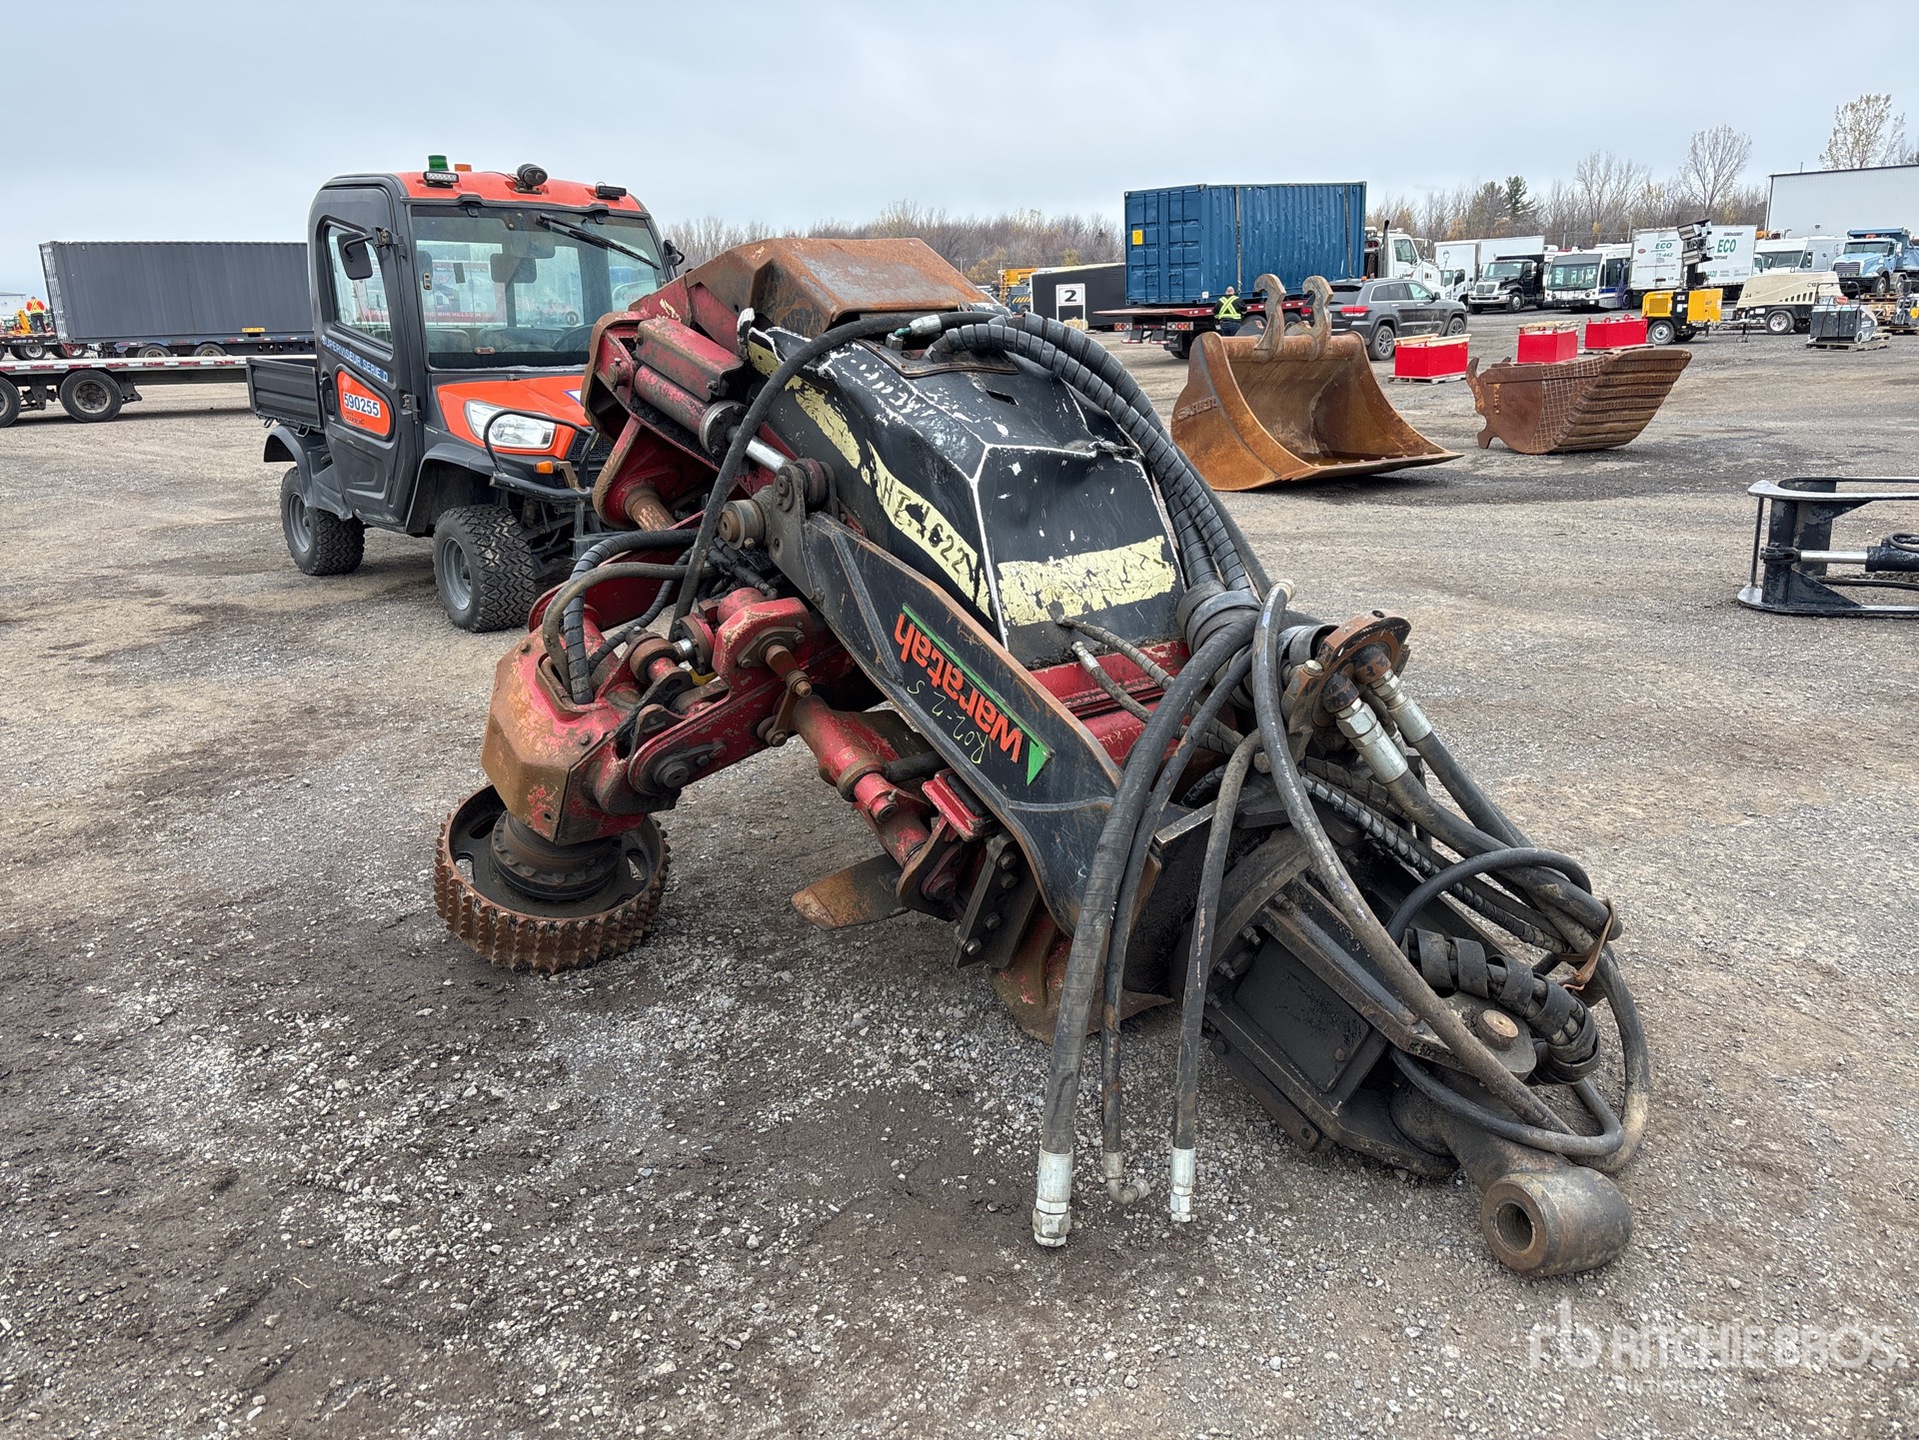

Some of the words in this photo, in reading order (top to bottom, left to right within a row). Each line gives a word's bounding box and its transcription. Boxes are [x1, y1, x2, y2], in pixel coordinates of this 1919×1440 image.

[1655, 242, 1673, 250] ECO
[1717, 238, 1737, 254] ECO
[1064, 289, 1077, 302] 2
[321, 335, 361, 367] SUPERVISEUR
[362, 360, 381, 378] SERIE
[381, 370, 389, 383] D
[344, 393, 380, 417] 590255
[894, 613, 1023, 764] waratah
